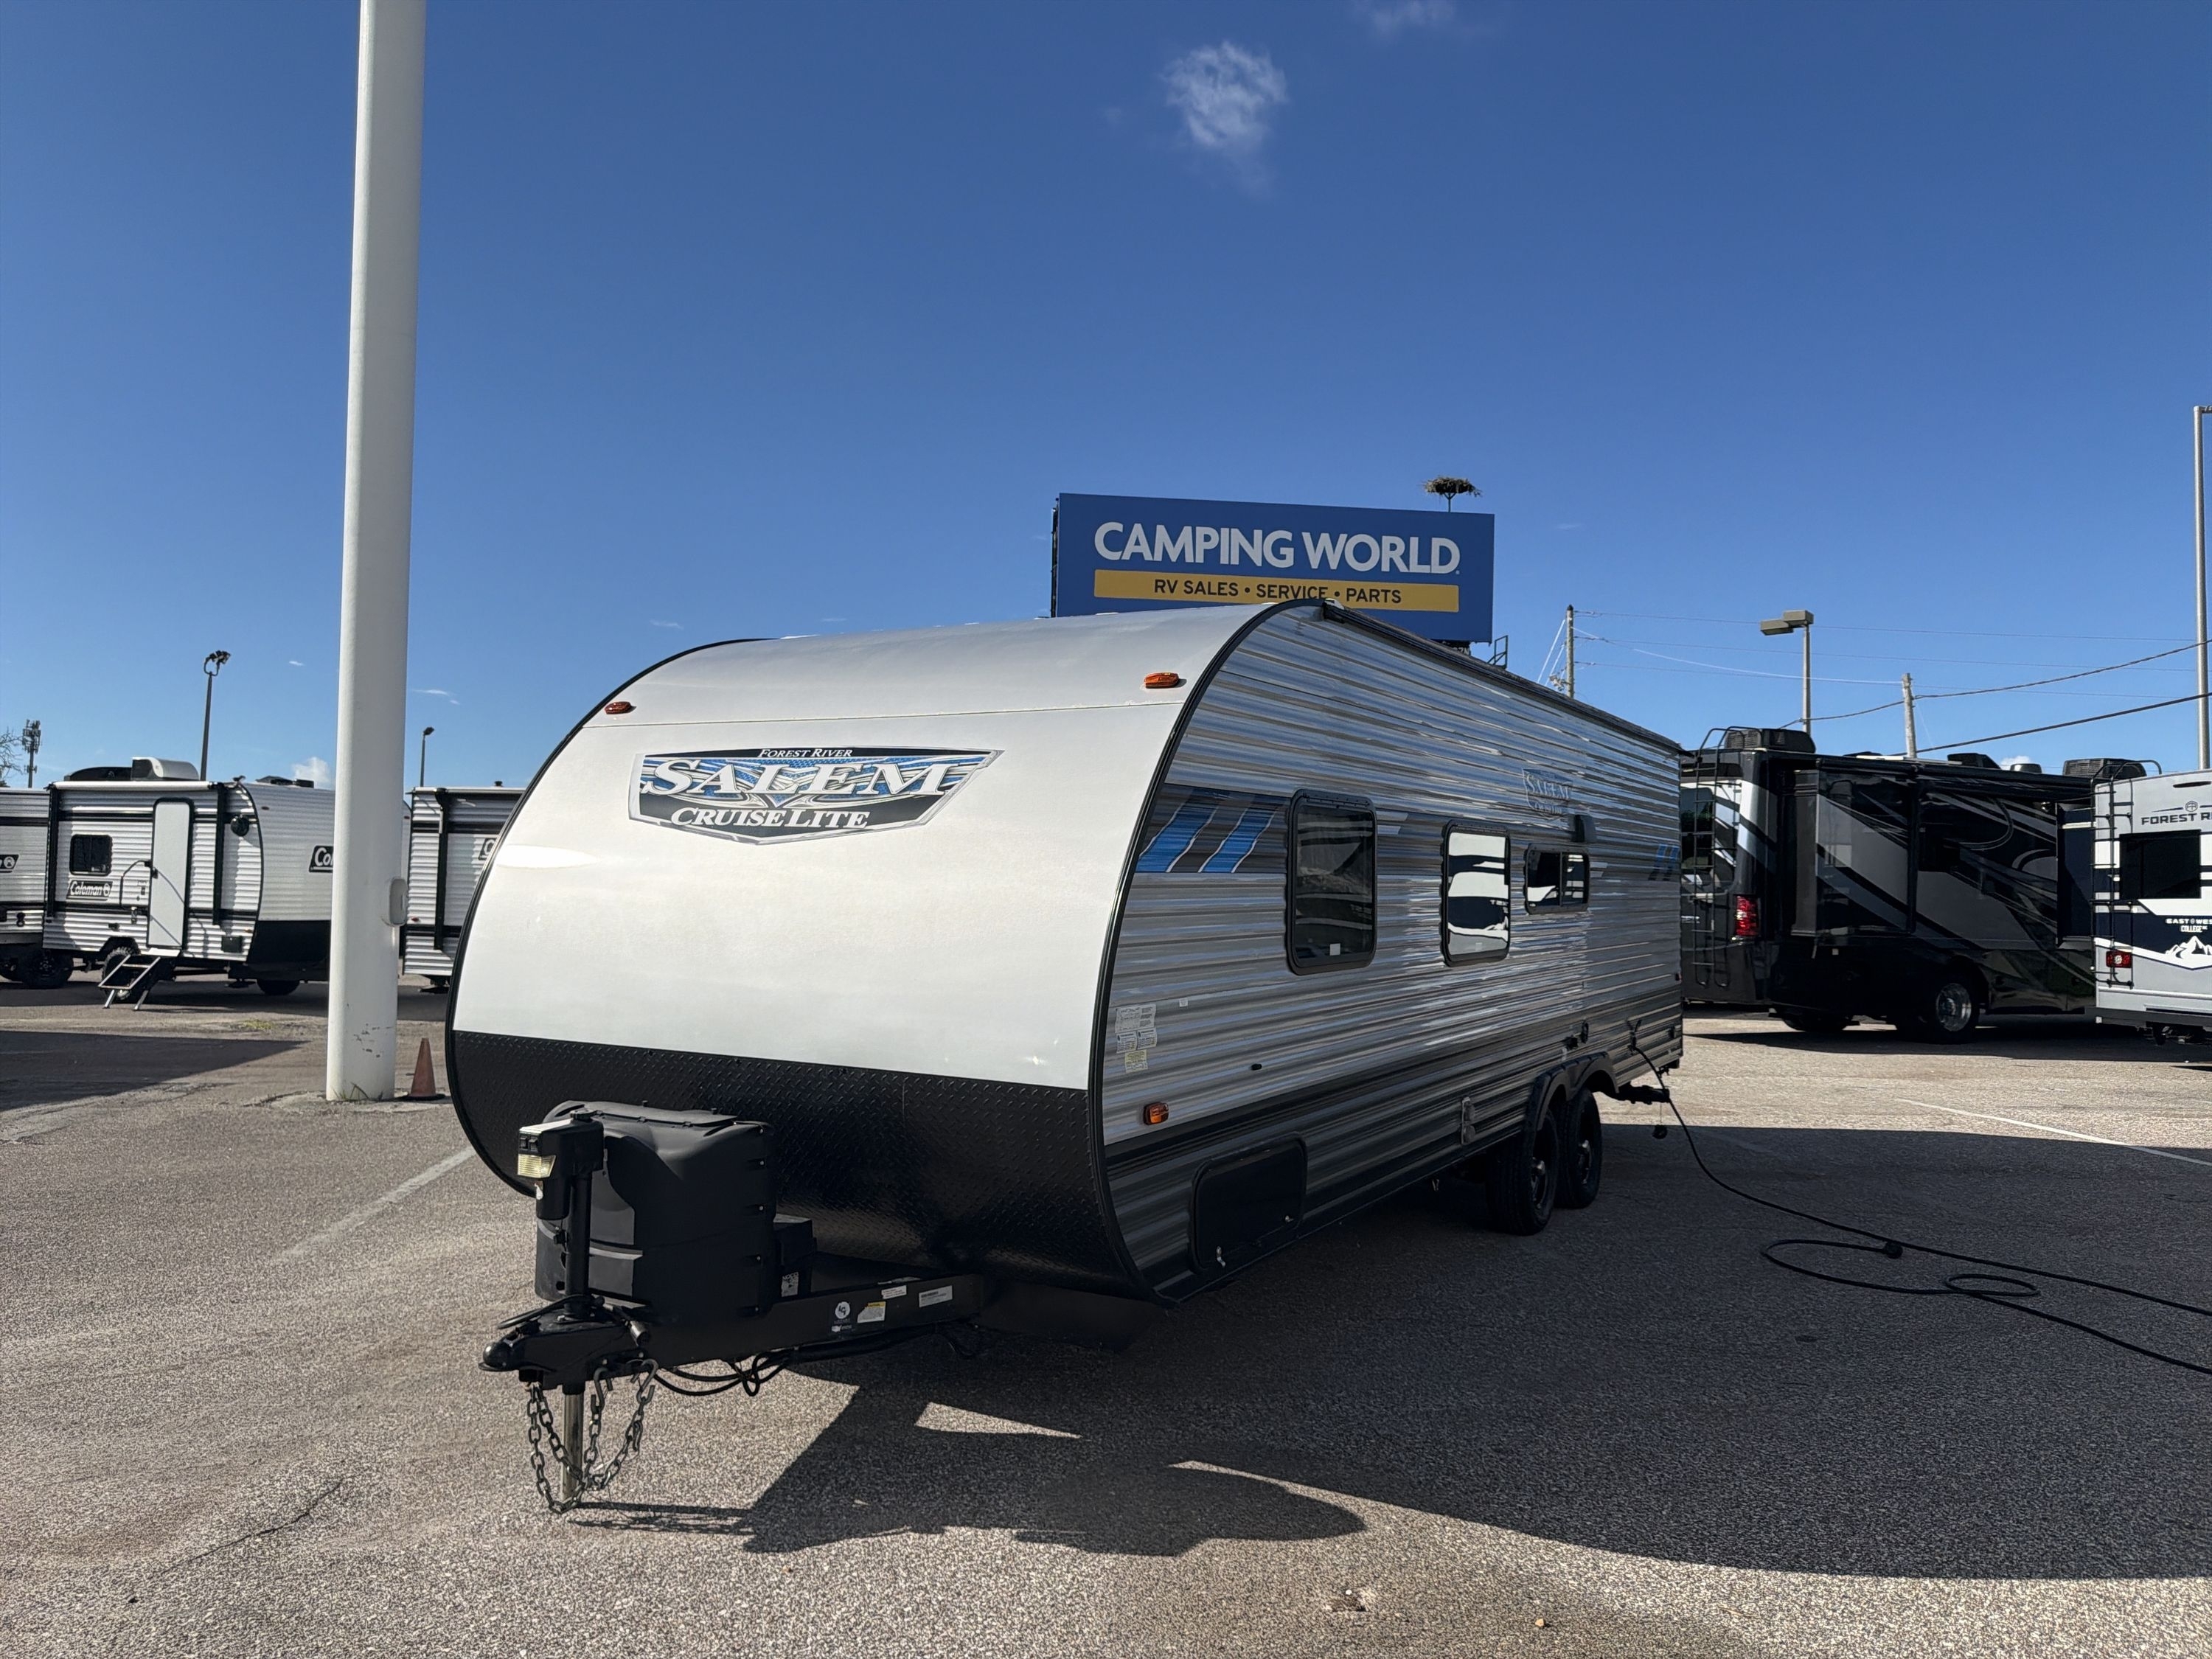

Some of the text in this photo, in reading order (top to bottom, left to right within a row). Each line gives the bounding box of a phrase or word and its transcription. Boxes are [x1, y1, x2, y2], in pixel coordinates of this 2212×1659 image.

[1094, 521, 1461, 574] CAMPING WORLD
[1154, 579, 1402, 604] RV SALES SERVICE PARTS
[757, 748, 853, 758] FOREST RIVER
[641, 759, 961, 796] SALEM
[2140, 813, 2197, 825] FOREST
[70, 880, 103, 896] Coleman
